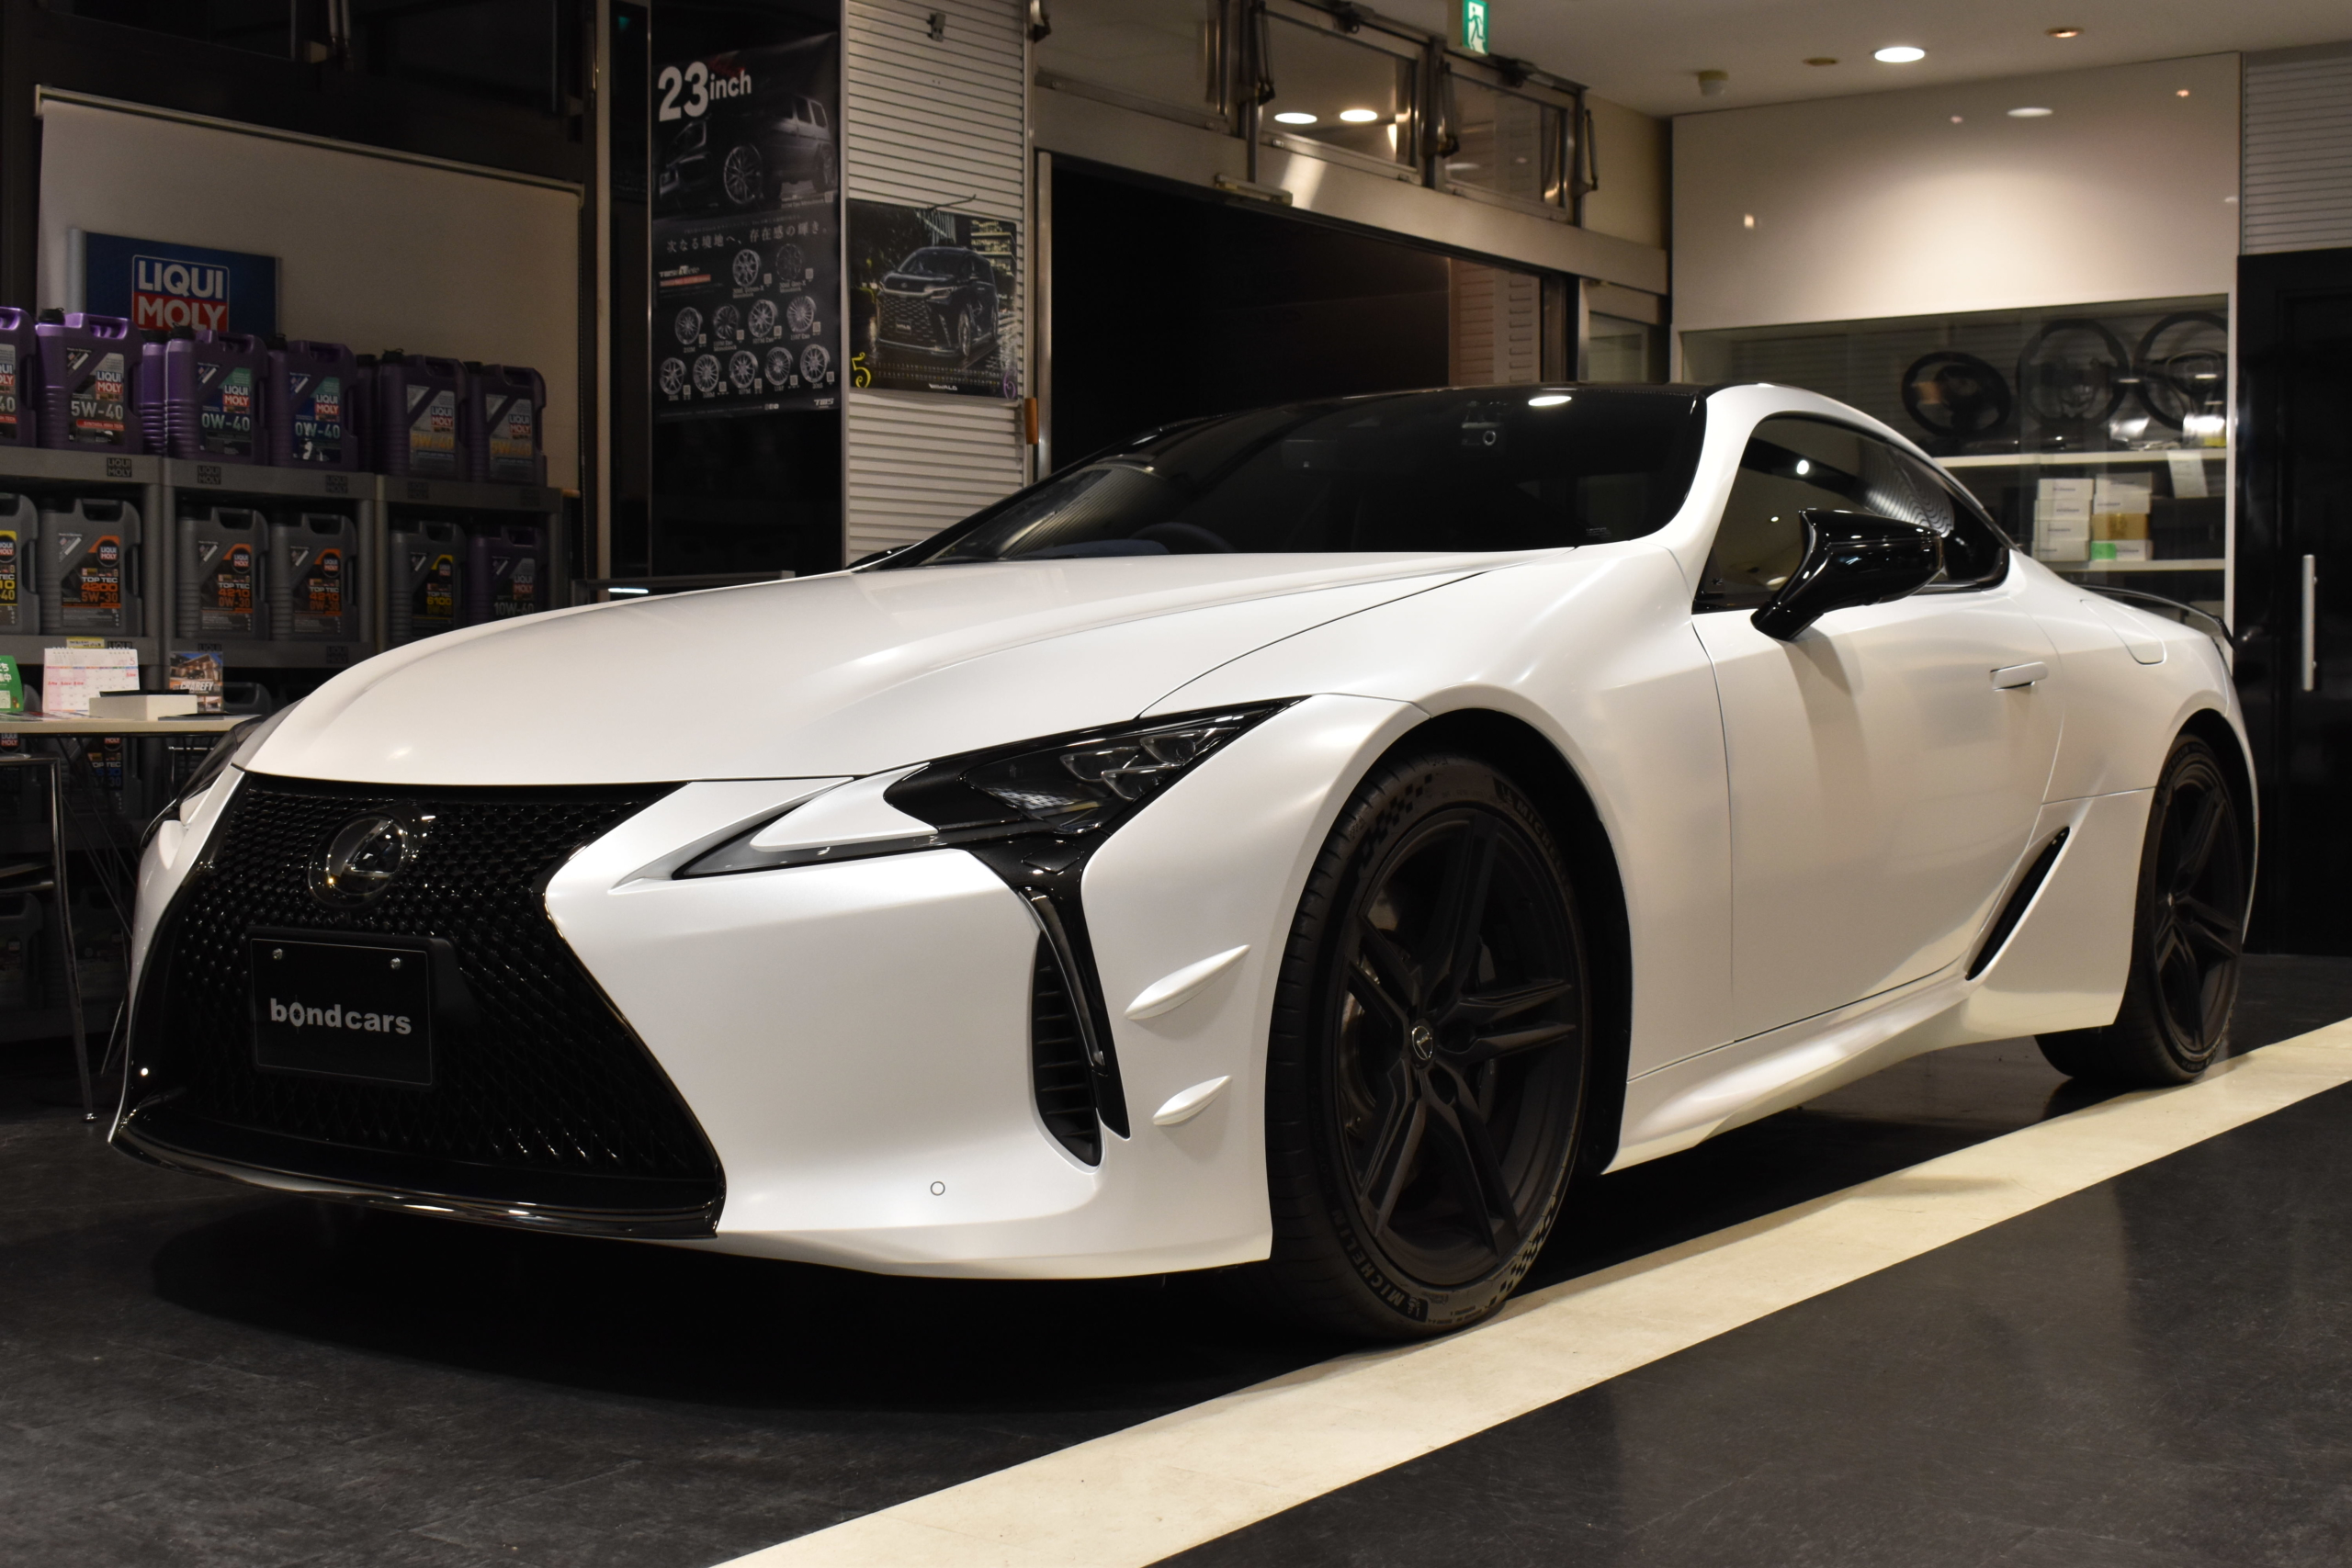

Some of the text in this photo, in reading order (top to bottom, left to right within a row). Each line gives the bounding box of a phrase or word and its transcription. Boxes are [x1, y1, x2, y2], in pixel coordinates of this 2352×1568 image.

[138, 260, 223, 299] LIQUI
[138, 295, 226, 332] MOLY
[851, 352, 872, 388] 5
[96, 371, 121, 382] LIQUI
[97, 382, 122, 394] MOLY
[224, 385, 249, 396] LIQUI
[224, 395, 250, 407] MOLY
[316, 394, 339, 405] LIQUI
[71, 400, 124, 420] 5W-40
[316, 404, 340, 415] MOLY
[432, 406, 453, 417] LIQUI
[201, 412, 251, 432] 0W-40
[432, 416, 453, 427] MOLY
[510, 414, 530, 425] LIQUI
[295, 422, 341, 439] 0W-40
[510, 423, 531, 435] MOLY
[107, 458, 131, 468] LIQUI
[107, 468, 131, 477] MOLY
[198, 465, 220, 474] LIQUI
[198, 475, 220, 484] MOLY
[514, 574, 532, 583] LIQUI
[81, 582, 119, 592] 4200
[514, 582, 534, 592] MOLY
[81, 592, 118, 603] 5W-30
[218, 589, 250, 597] 4210
[310, 592, 339, 601] 4210
[218, 598, 251, 607] 0W-30
[494, 602, 535, 615] 10W-60
[269, 996, 412, 1034] bondcars
[1331, 1207, 1405, 1307] MICHELIN
